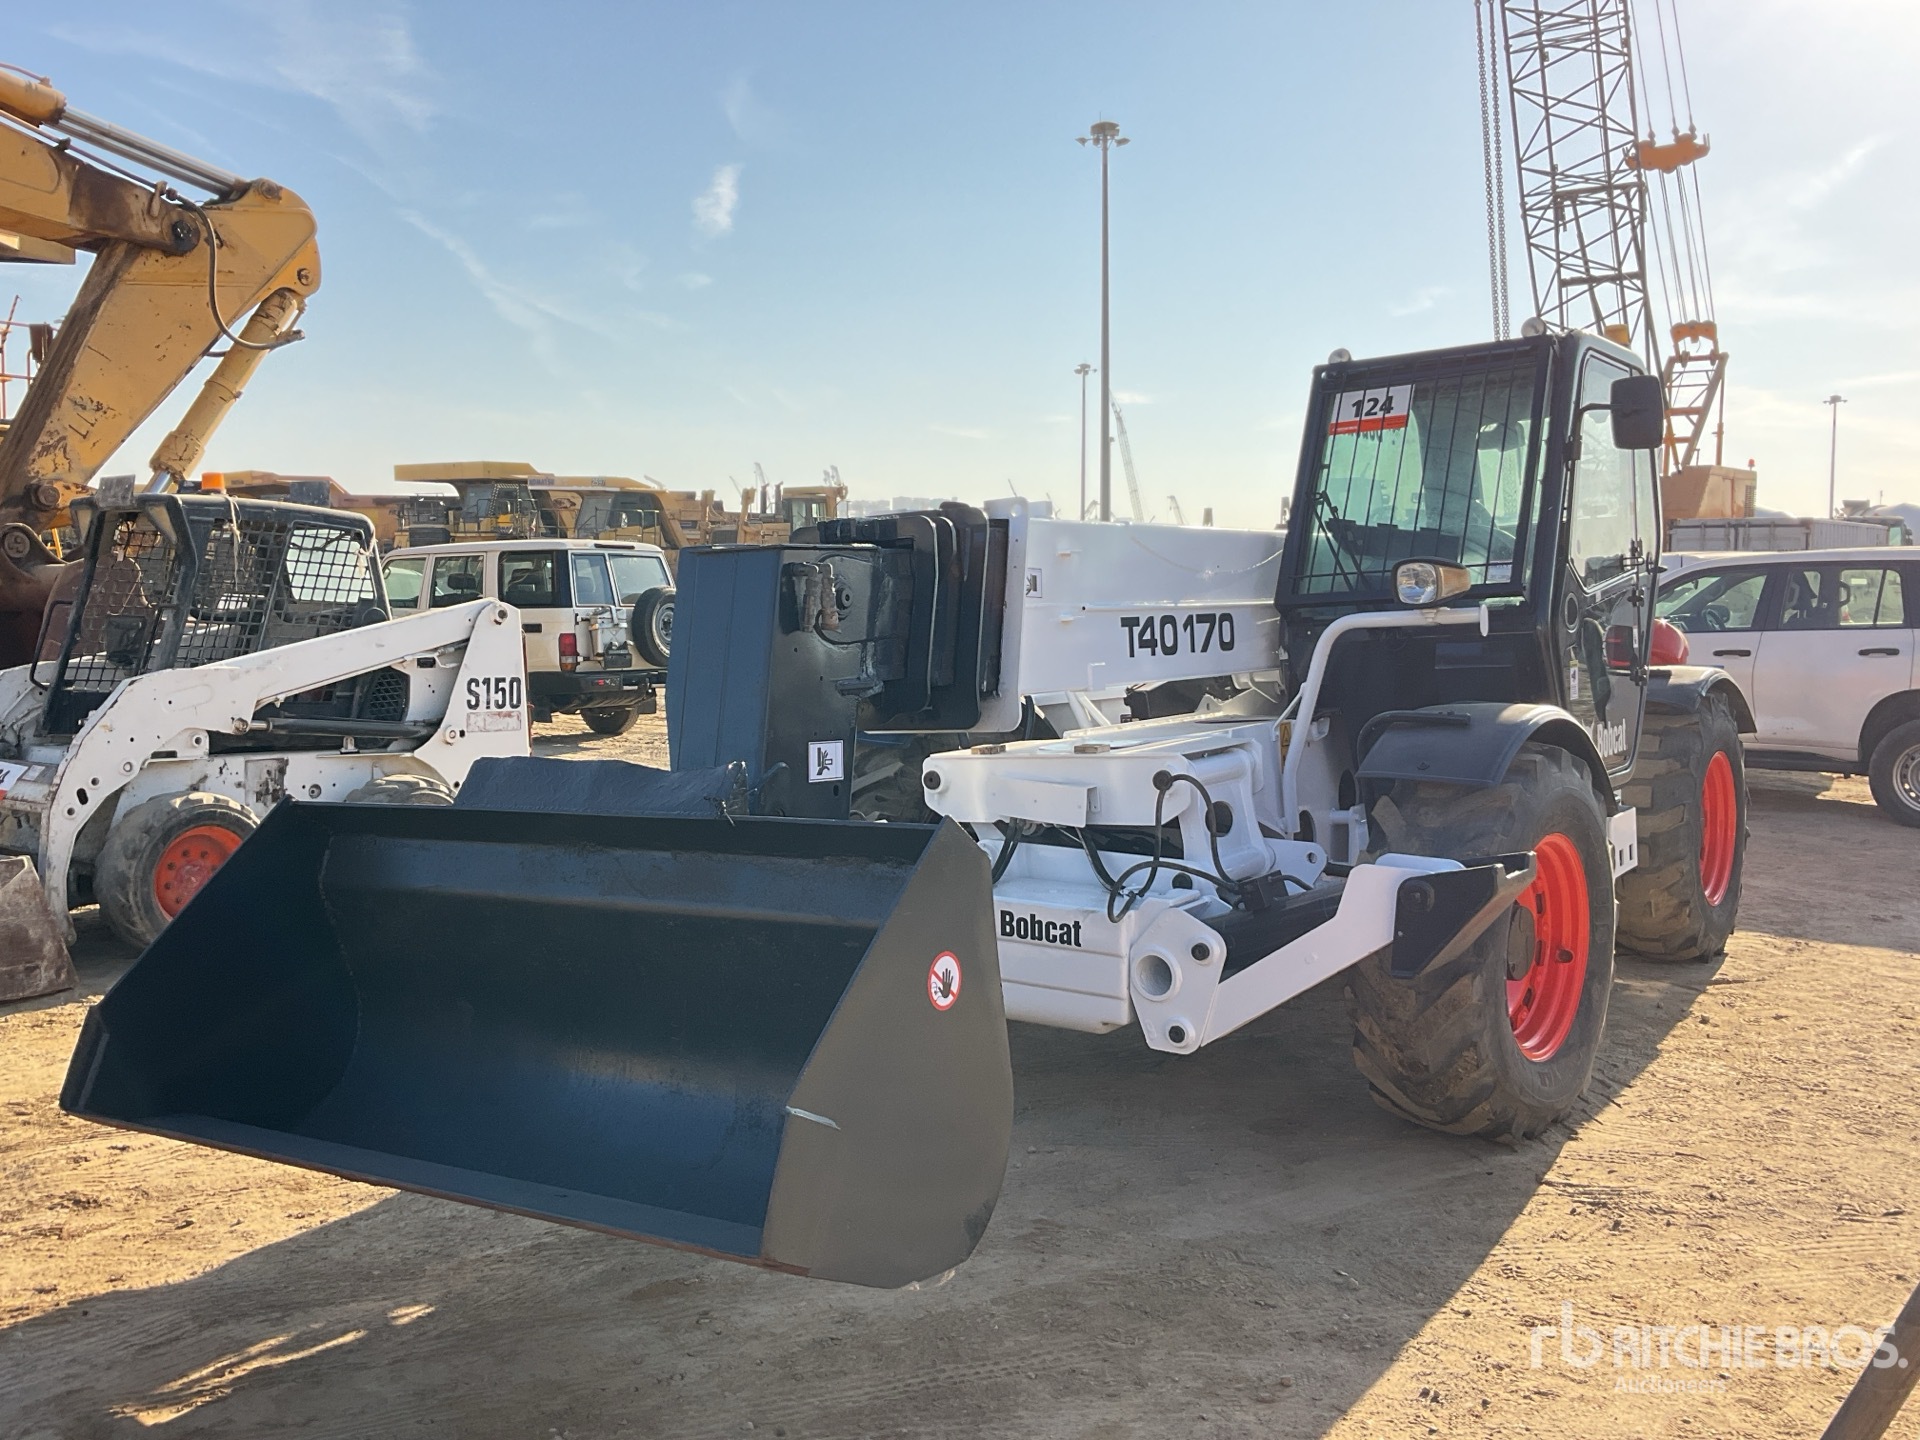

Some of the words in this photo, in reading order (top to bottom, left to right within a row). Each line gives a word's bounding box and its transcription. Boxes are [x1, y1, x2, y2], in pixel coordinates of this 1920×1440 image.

[1352, 395, 1394, 418] 124
[1120, 612, 1235, 658] T40170
[466, 677, 522, 710] S150
[1597, 718, 1627, 758] Bobcat
[1000, 909, 1082, 948] Bobcat
